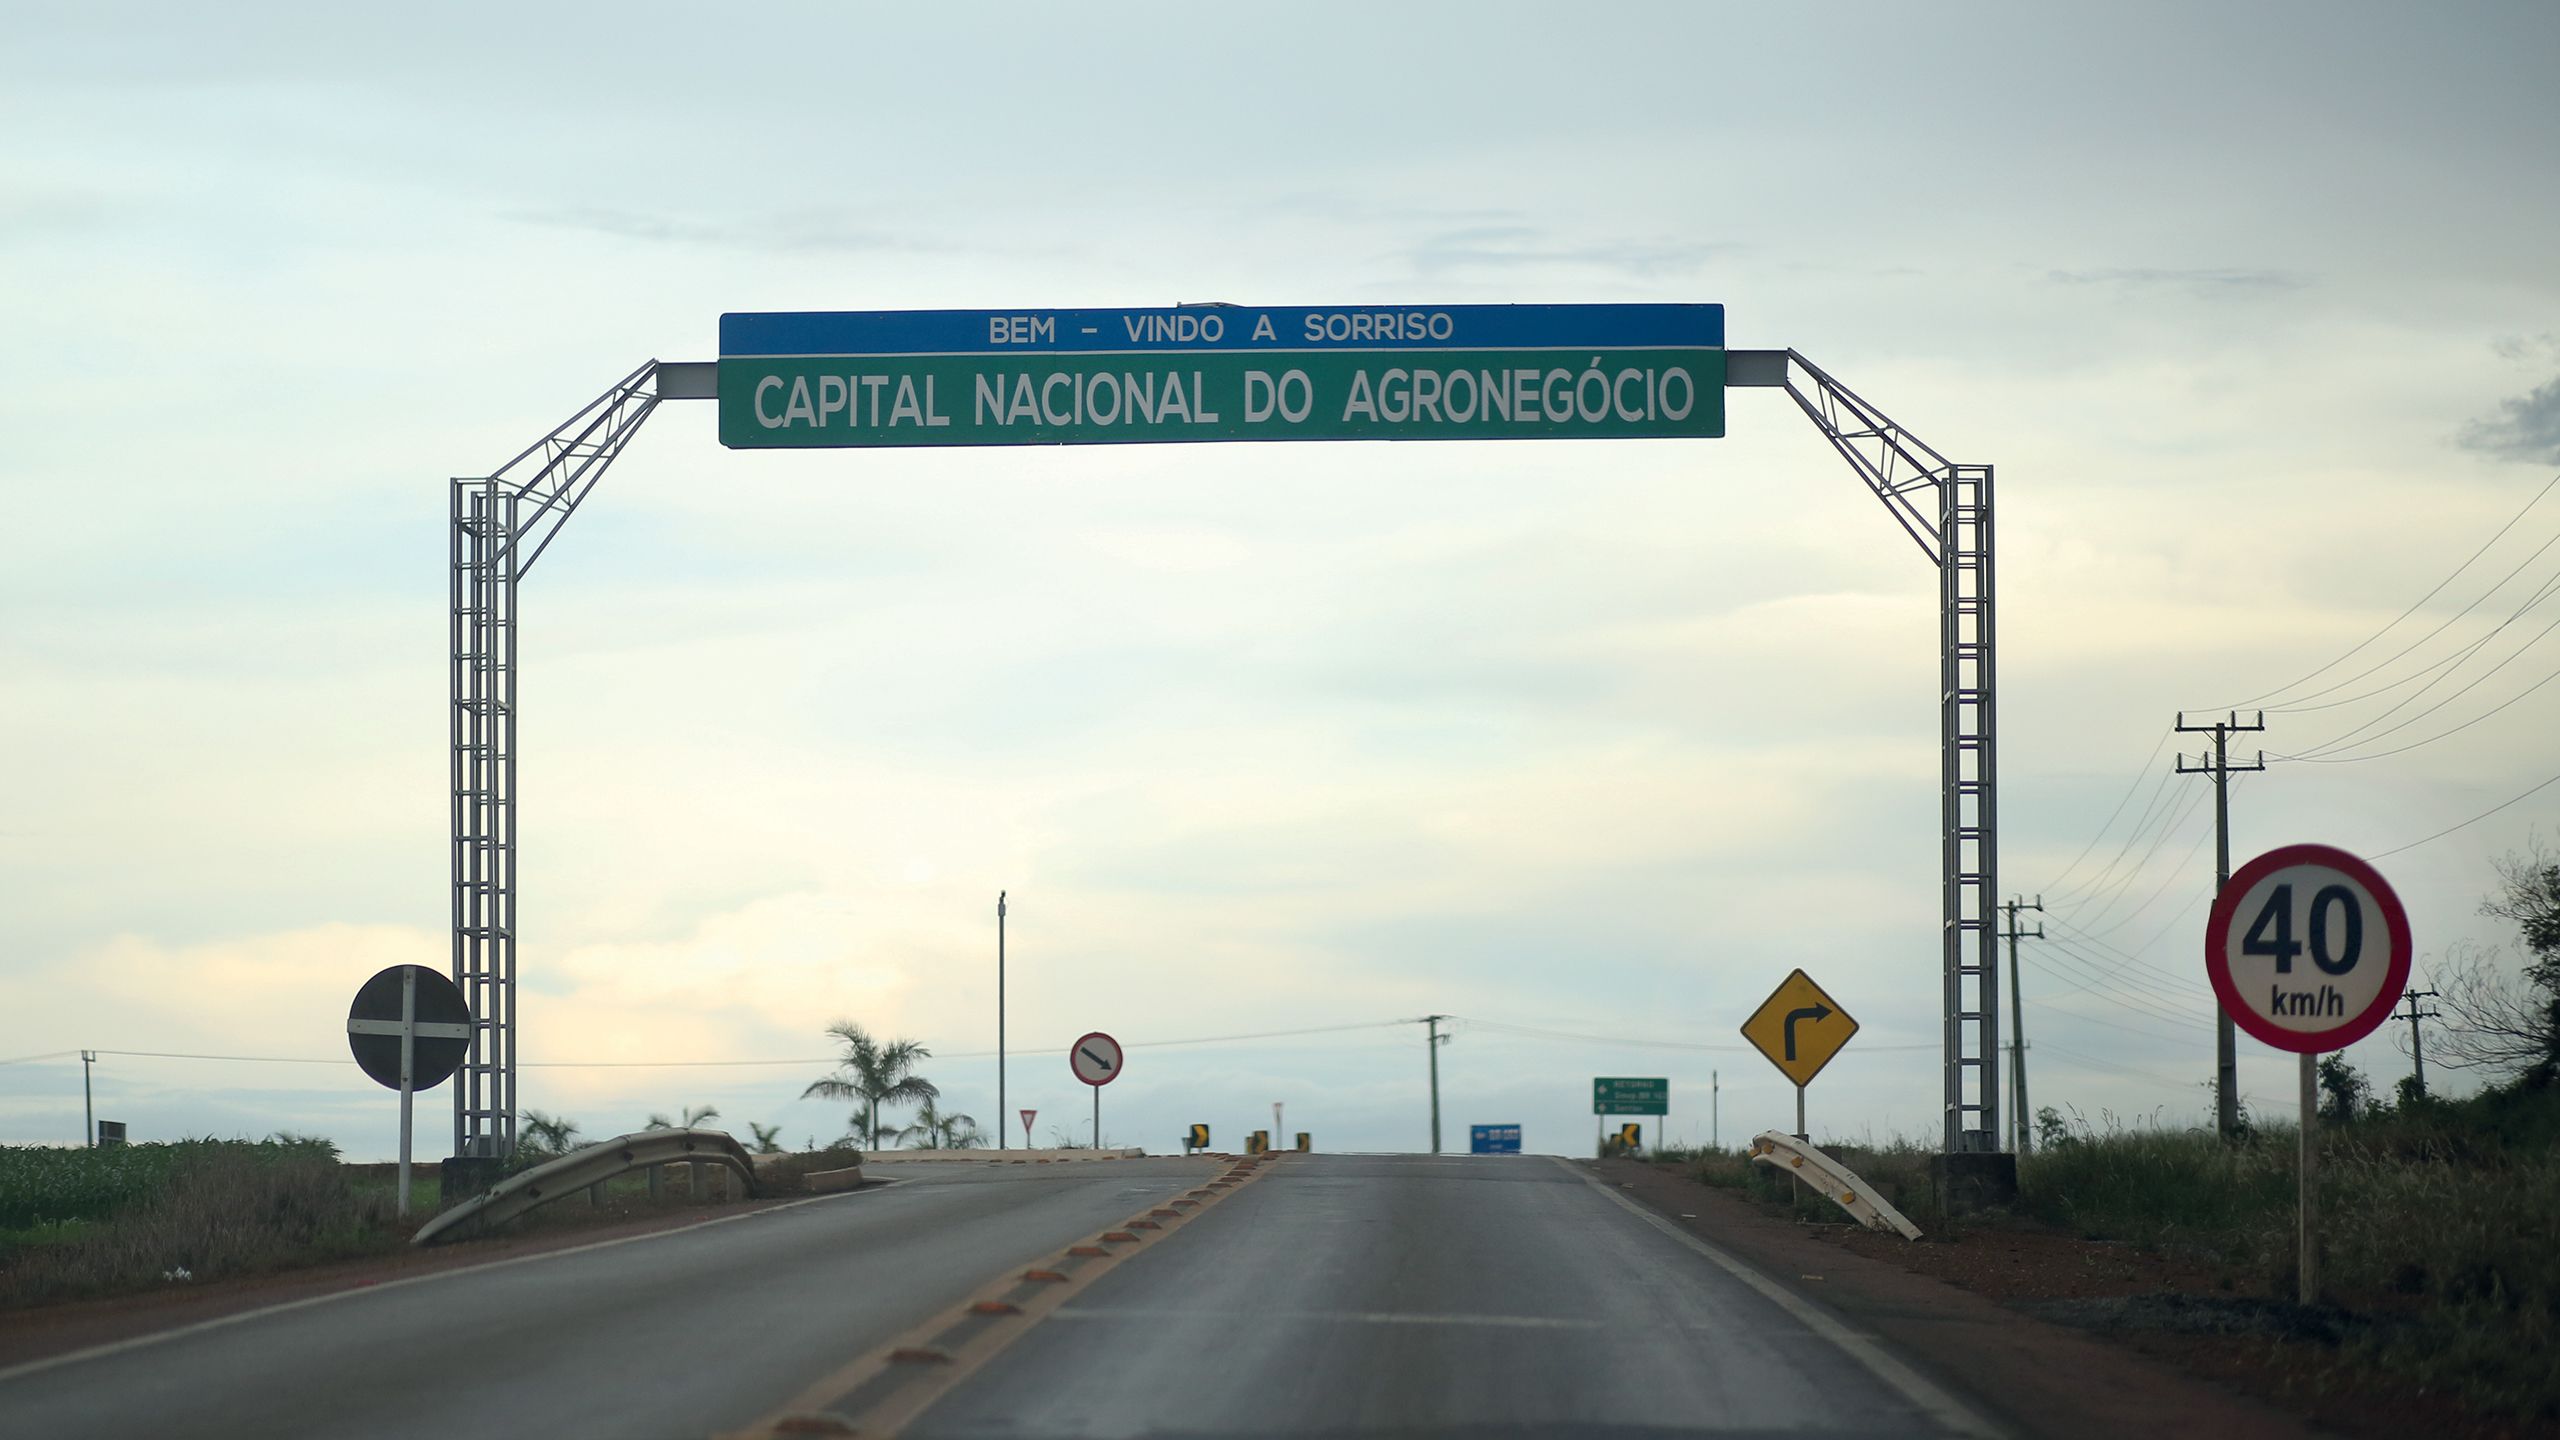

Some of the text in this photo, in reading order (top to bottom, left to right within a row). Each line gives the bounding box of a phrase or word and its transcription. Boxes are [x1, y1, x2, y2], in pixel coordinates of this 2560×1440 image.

[989, 316, 1055, 344] BEM
[1123, 314, 1225, 343] VINDO
[1251, 314, 1278, 341] A
[1304, 312, 1454, 342] SORRISO
[754, 356, 1695, 429] CAPITAL NACIONAL DO AGRONEGÓCIO
[2242, 883, 2363, 976] 40
[2271, 984, 2344, 1017] km/h
